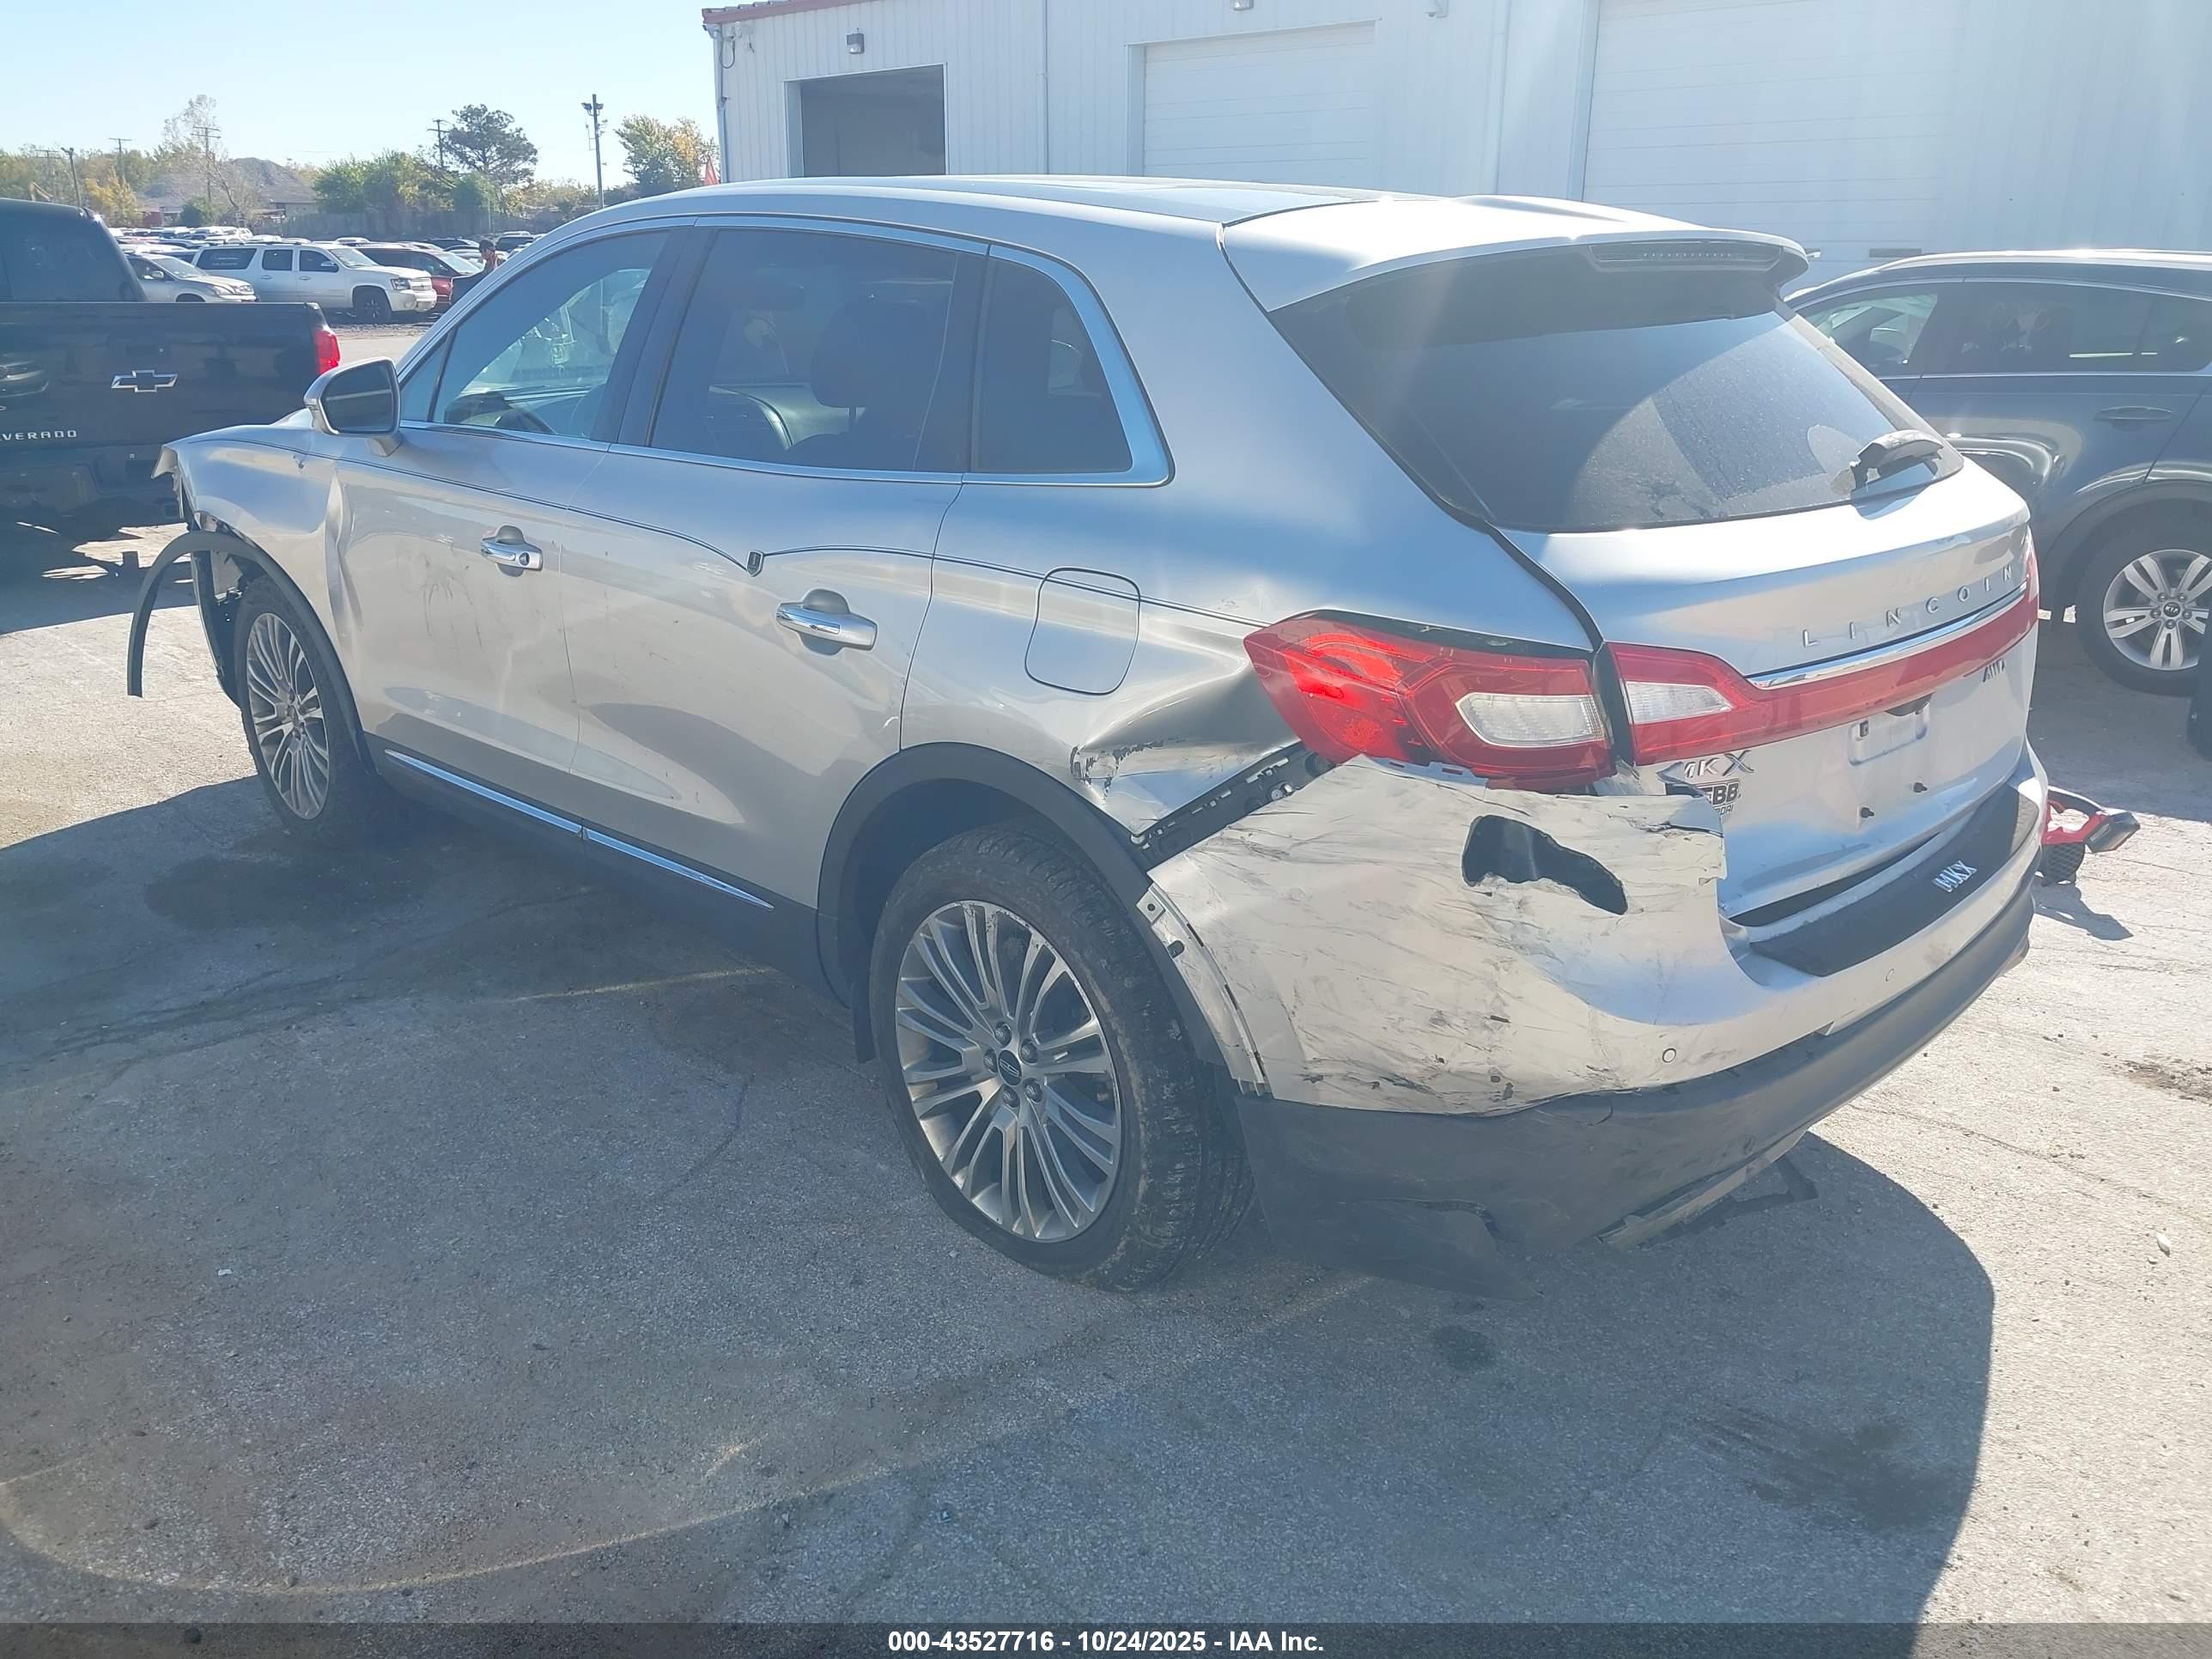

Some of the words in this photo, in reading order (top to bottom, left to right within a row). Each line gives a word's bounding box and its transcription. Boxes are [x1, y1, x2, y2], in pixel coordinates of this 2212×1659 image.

[0, 429, 77, 441] VERADO
[1802, 564, 2012, 647] LINCOLN
[1932, 860, 1978, 892] MKX
